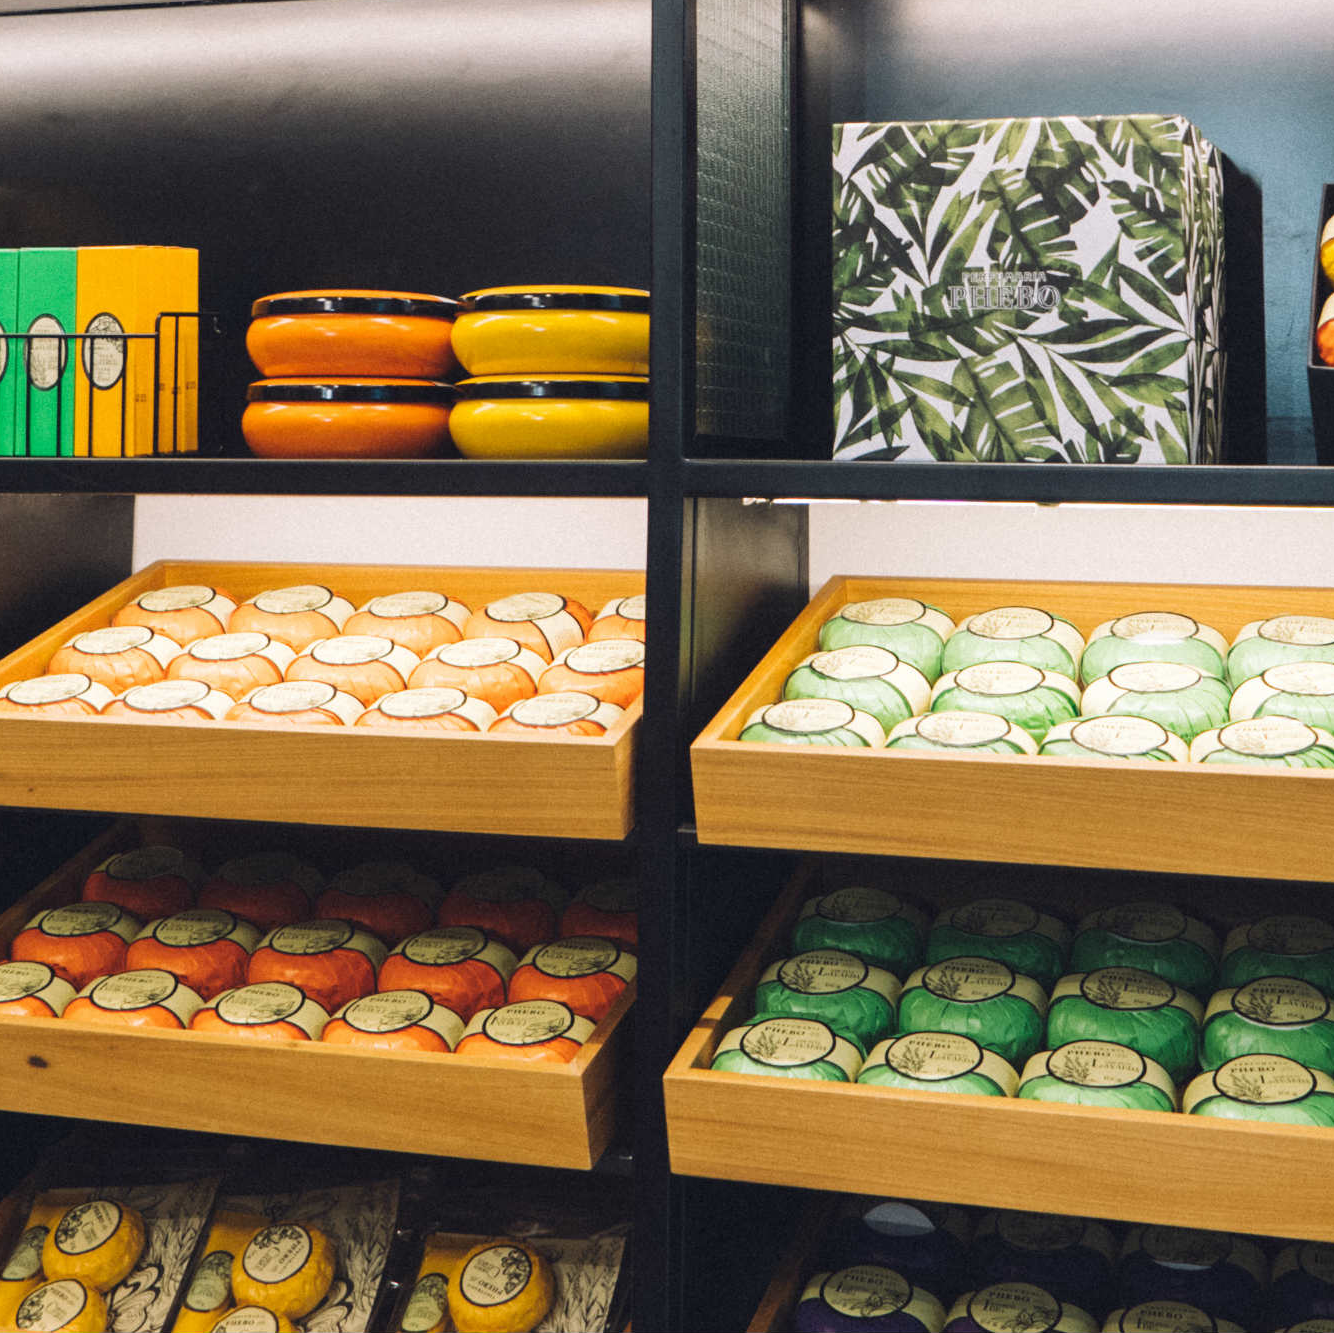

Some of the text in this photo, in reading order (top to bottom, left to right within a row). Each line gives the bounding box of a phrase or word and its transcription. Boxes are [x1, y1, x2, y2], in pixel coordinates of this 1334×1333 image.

[961, 269, 1047, 283] PERFUMARIA
[946, 283, 1062, 312] PHEBO
[505, 1008, 547, 1017] PHEBO
[1066, 1049, 1112, 1059] PHEBO
[1229, 1065, 1277, 1074] PHEBO
